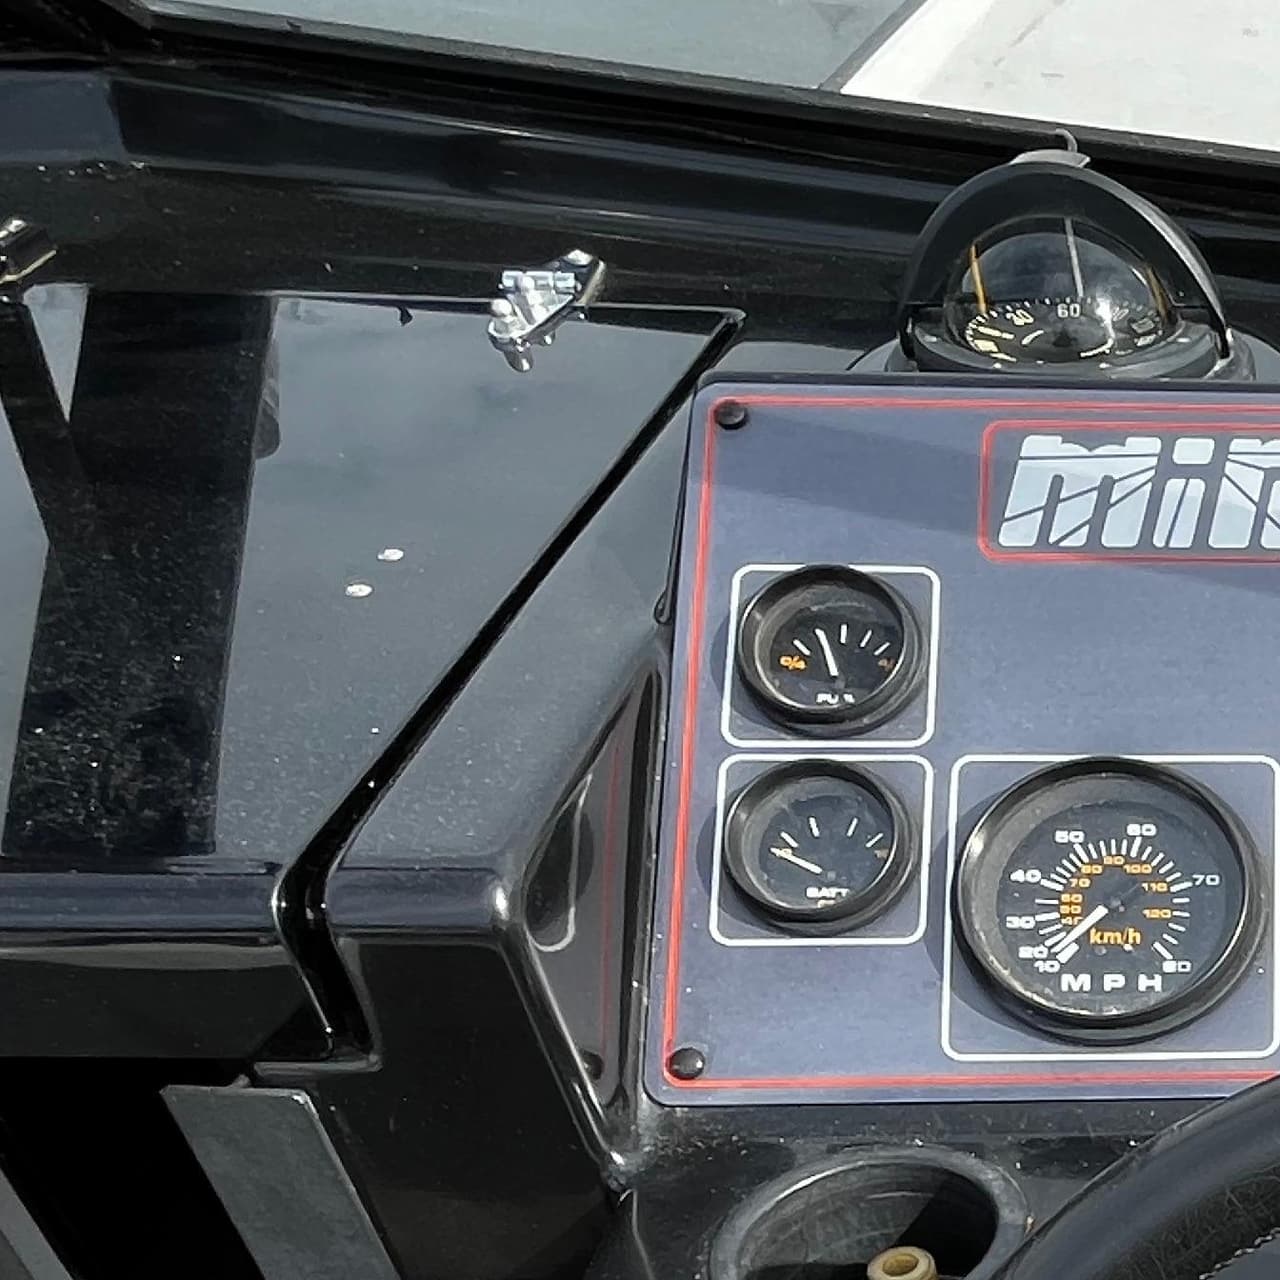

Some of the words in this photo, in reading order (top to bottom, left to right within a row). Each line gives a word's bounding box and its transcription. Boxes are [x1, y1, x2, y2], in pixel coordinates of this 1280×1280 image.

[1057, 303, 1080, 318] 60
[1055, 830, 1086, 843] 50
[1126, 824, 1157, 837] 60
[1123, 864, 1153, 874] 100
[1010, 869, 1042, 884] 40
[1193, 874, 1221, 886] 70
[1069, 879, 1091, 888] 70
[1142, 883, 1168, 892] 110
[1142, 909, 1172, 919] 120
[1006, 916, 1036, 929] 30
[1089, 928, 1142, 945] km/h
[1034, 961, 1061, 974] 10
